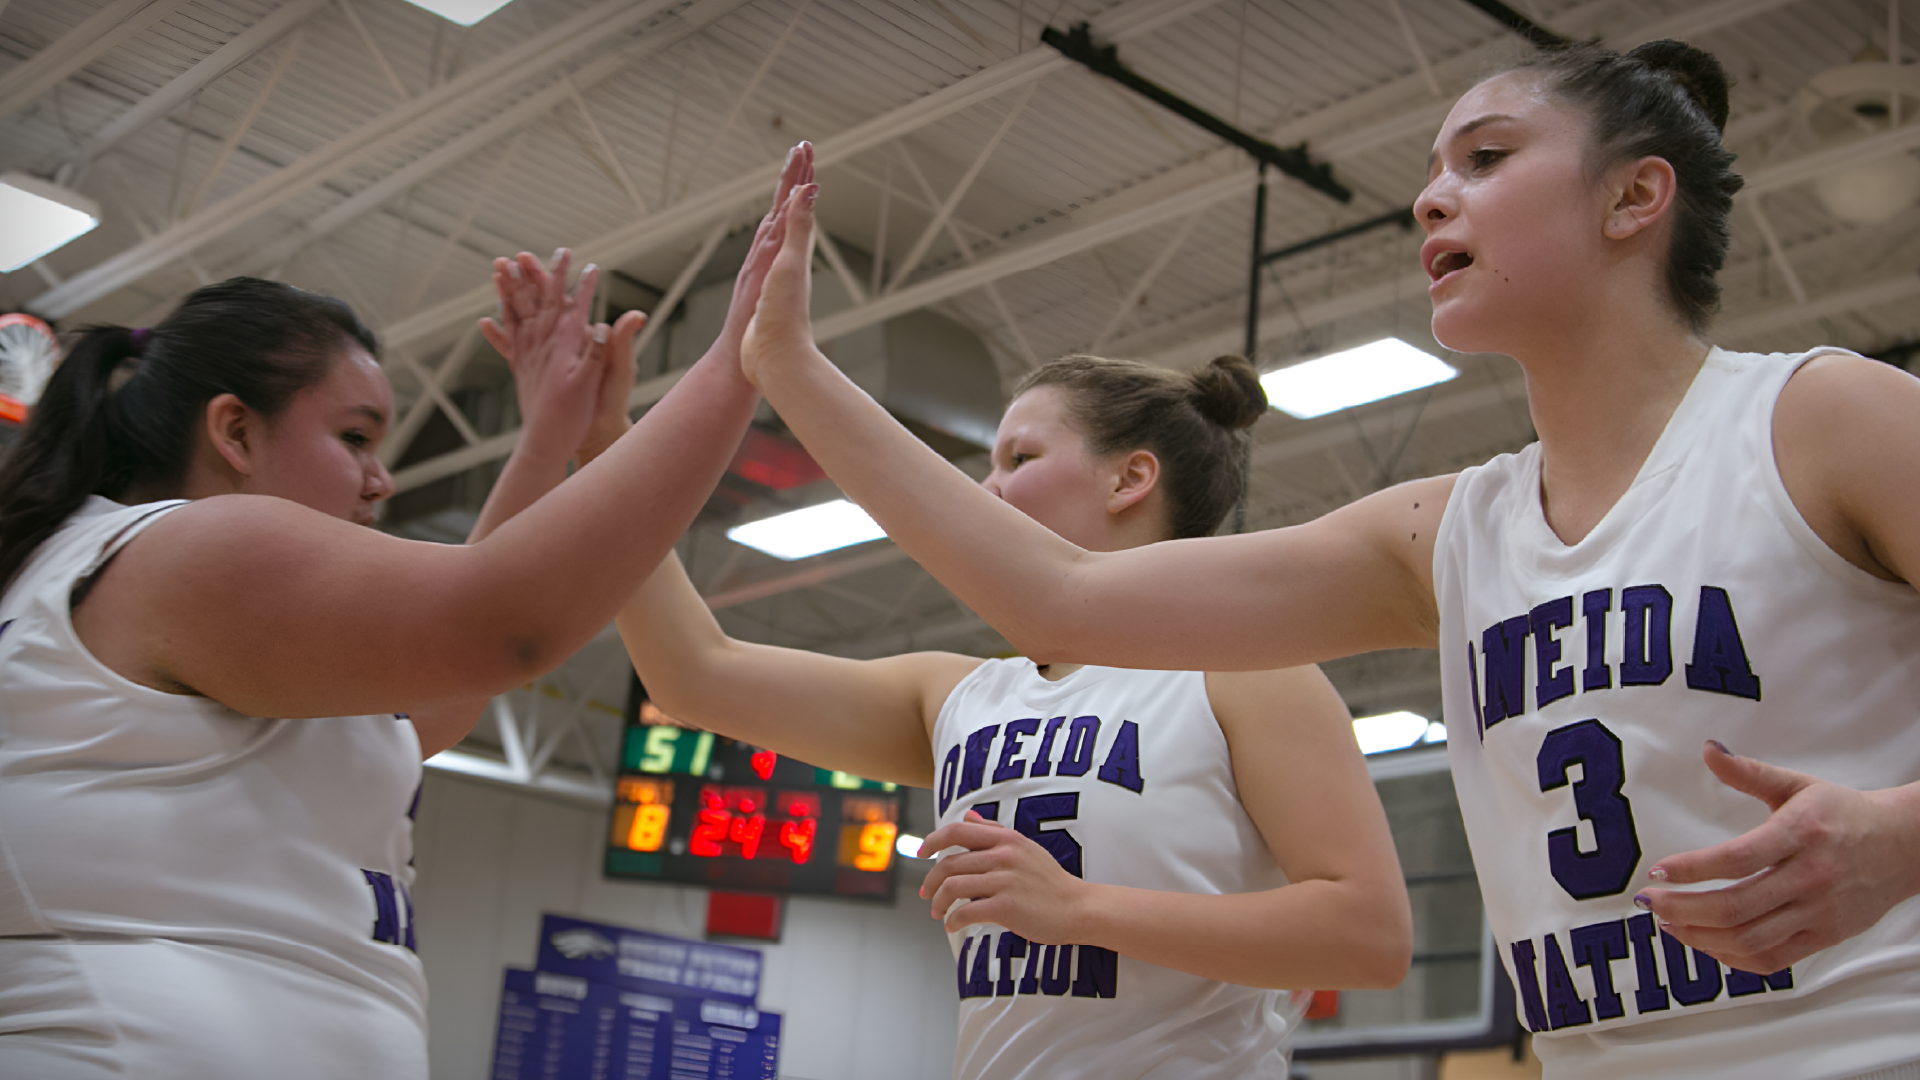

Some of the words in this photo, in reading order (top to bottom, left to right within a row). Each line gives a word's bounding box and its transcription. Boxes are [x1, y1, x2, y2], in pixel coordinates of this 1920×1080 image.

[1468, 584, 1761, 743] NEIDA
[639, 725, 716, 776] 51
[939, 715, 1145, 819] ONEIDA
[628, 804, 671, 852] 8
[854, 821, 898, 872] 9
[970, 791, 1083, 880] 5
[1536, 718, 1642, 900] 3
